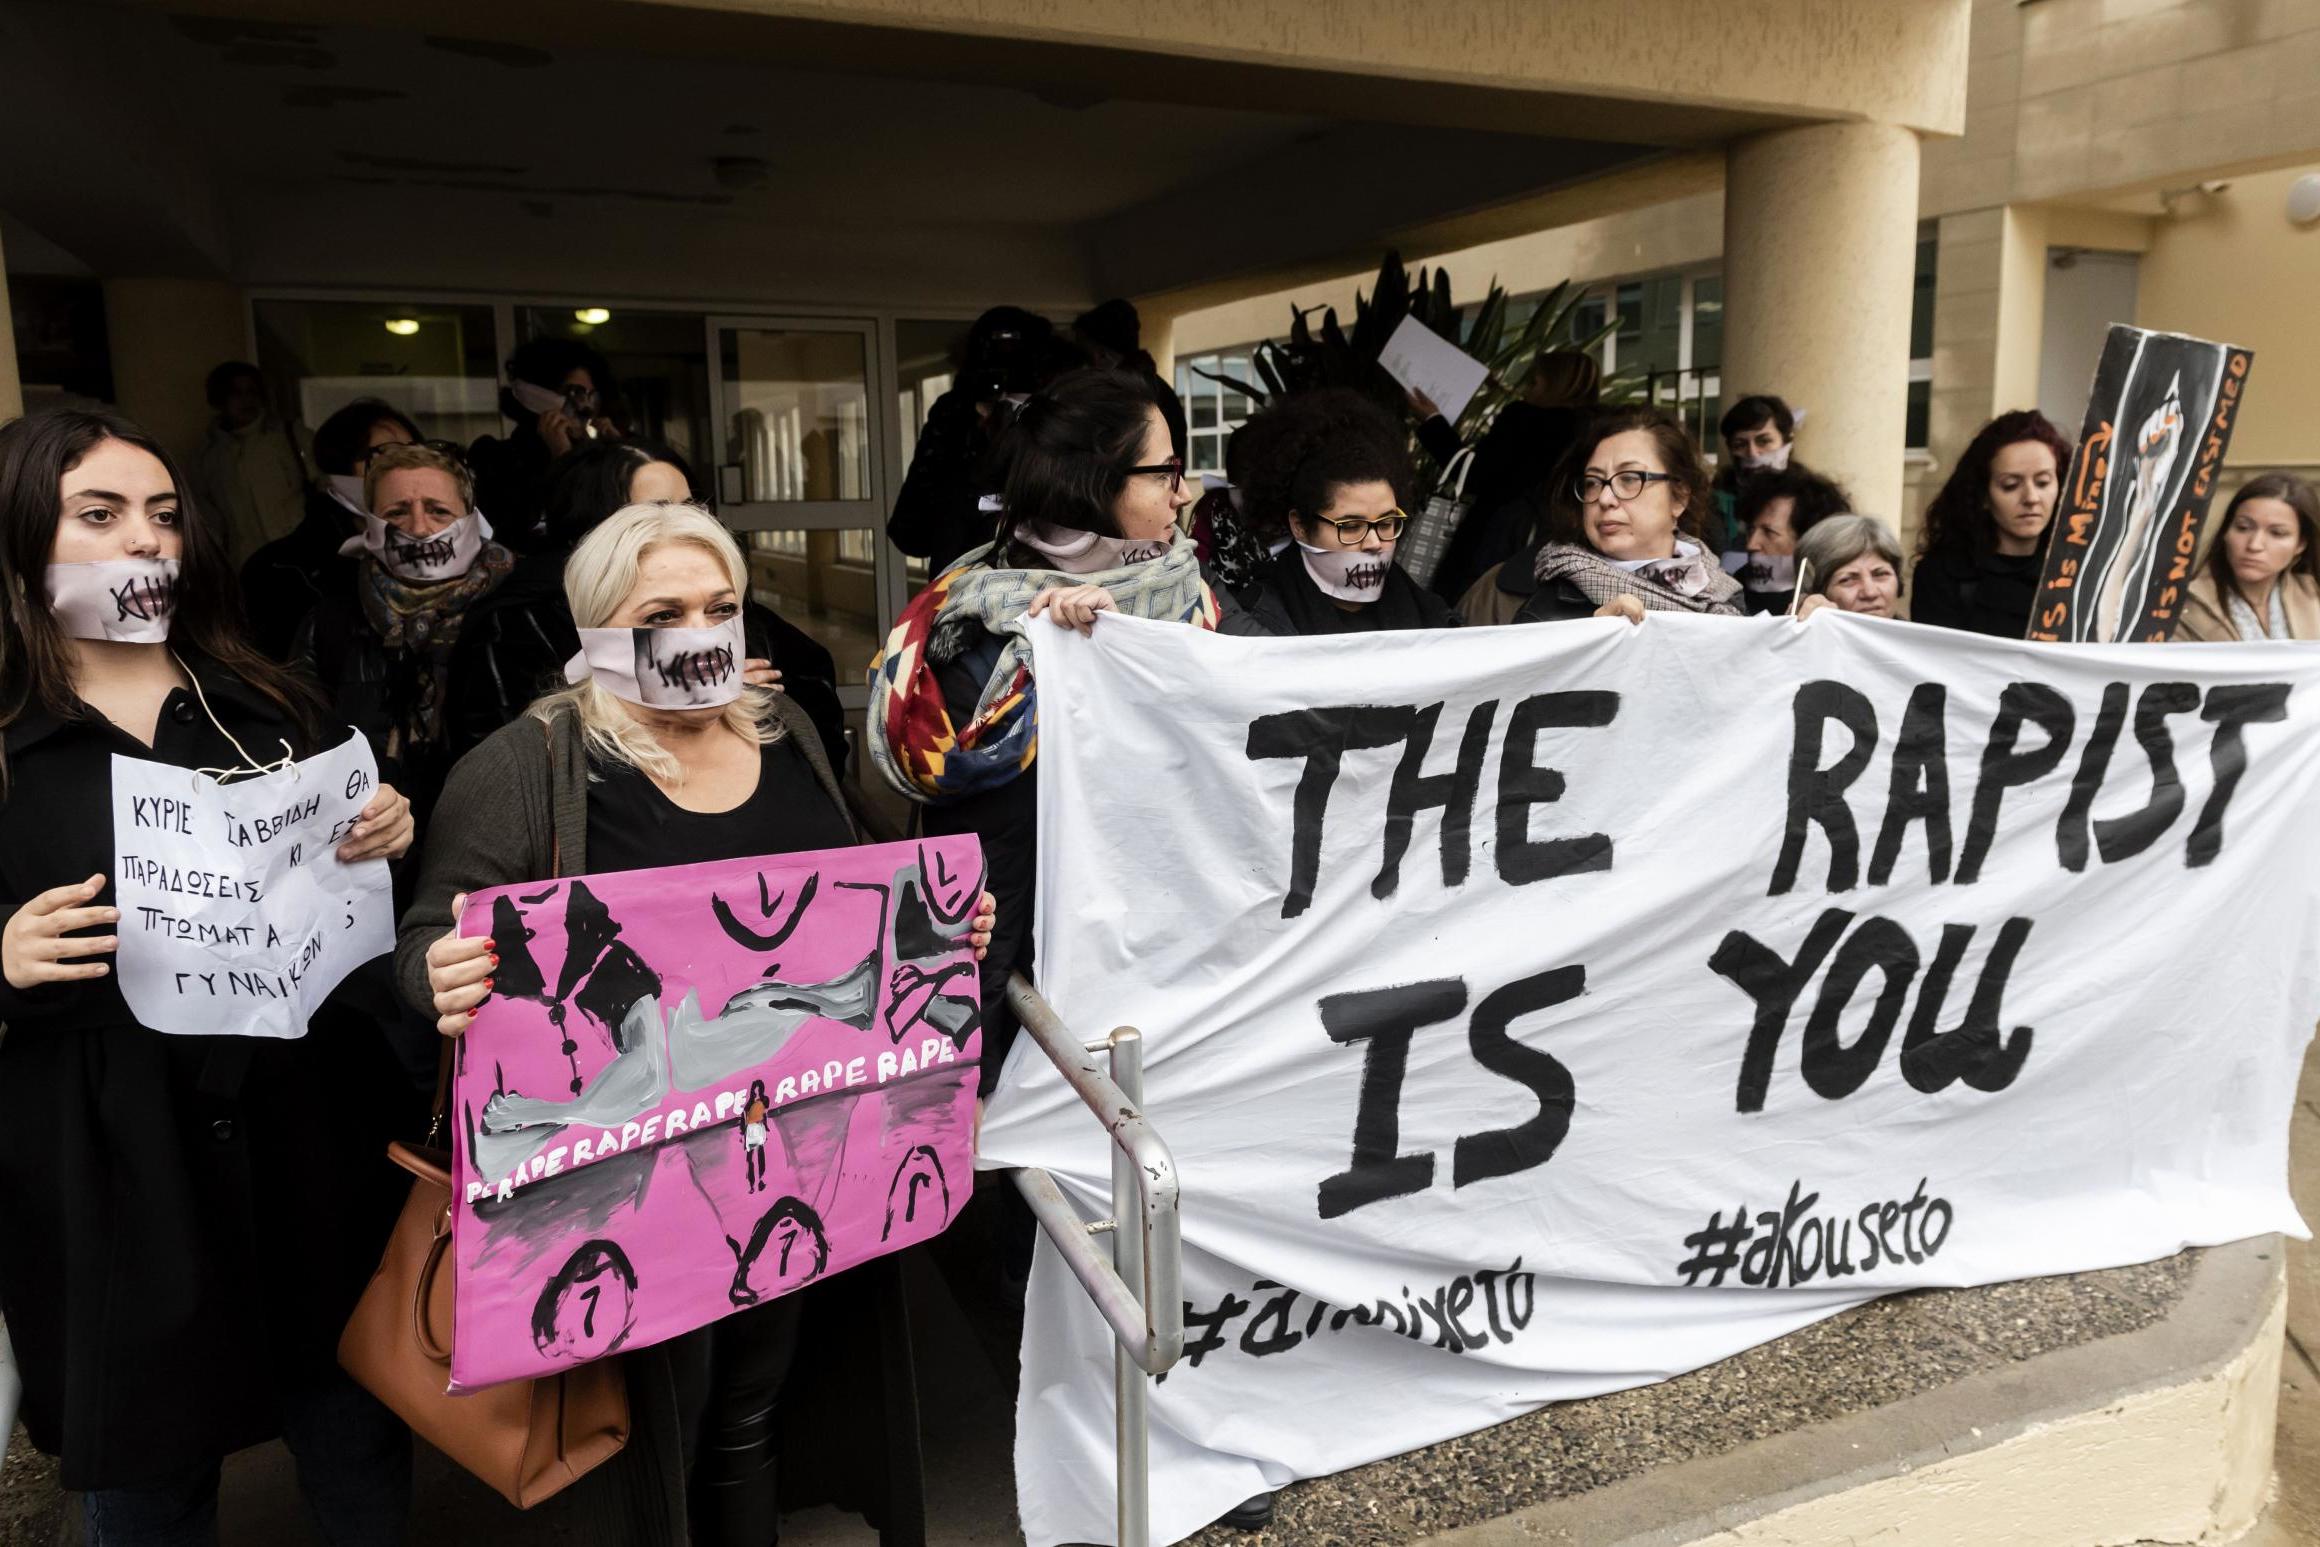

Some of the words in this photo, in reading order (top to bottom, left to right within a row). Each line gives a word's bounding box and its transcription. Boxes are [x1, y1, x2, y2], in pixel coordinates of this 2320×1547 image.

[2168, 510, 2197, 580] NOT
[132, 795, 192, 835] ΚΥΡΙΕ
[345, 769, 370, 800] ΘΑ
[1246, 690, 1620, 918] THE
[1767, 680, 2292, 896] RAPIST
[122, 855, 264, 902] ΠΑΡΑΔΩΣΕΙΣ
[289, 843, 302, 868] ΚΙ
[328, 814, 361, 845] ΕΣ
[572, 1113, 664, 1167] RAPE
[664, 1087, 749, 1141] RAPE
[774, 1055, 869, 1104] RAPE
[876, 1035, 955, 1084] RAPE
[1317, 964, 1588, 1219] IS
[1707, 908, 2033, 1113] YOU
